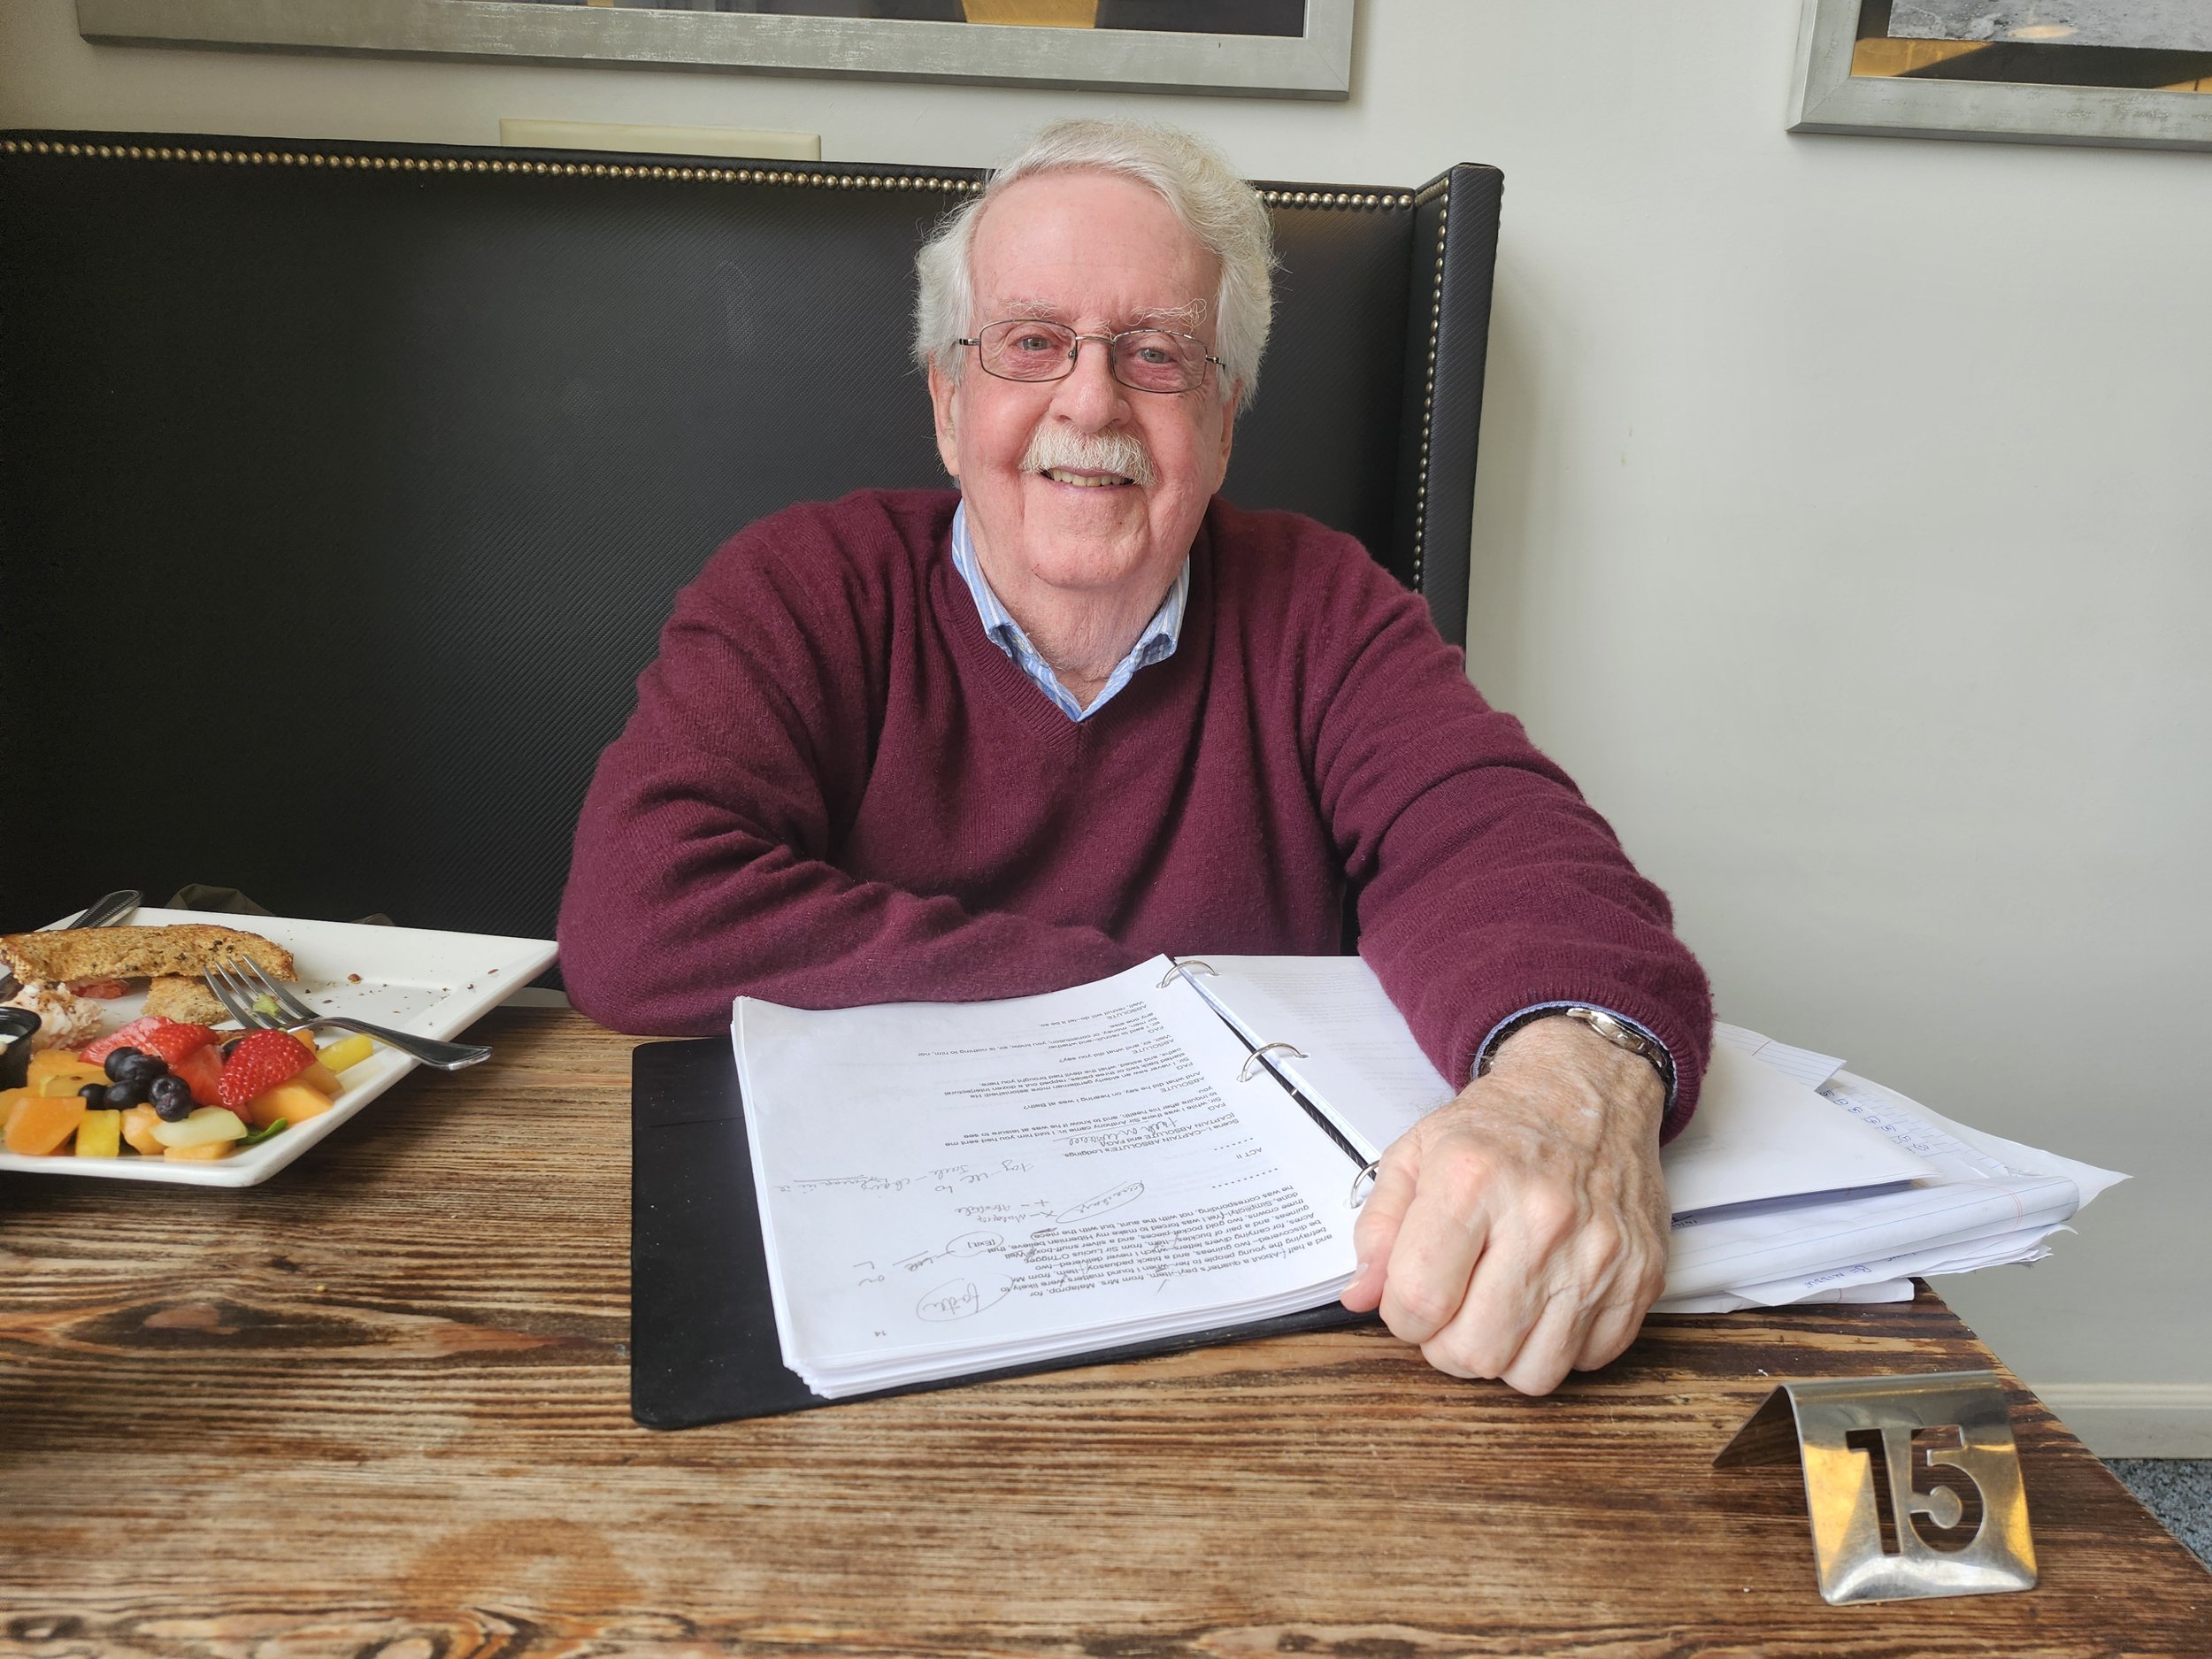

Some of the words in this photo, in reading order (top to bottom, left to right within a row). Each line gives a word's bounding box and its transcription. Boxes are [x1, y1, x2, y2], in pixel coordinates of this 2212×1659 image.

[1160, 1052, 1185, 1063] started
[1150, 1063, 1171, 1071] never
[1185, 1071, 1200, 1079] And
[1160, 1076, 1204, 1093] ABSOLUTE
[984, 1088, 1028, 1097] astonished!
[1181, 1094, 1209, 1104] inquire
[1094, 1119, 1126, 1129] Anthony
[1212, 1118, 1239, 1129] Scene
[1143, 1125, 1192, 1140] ABSOLUTE
[1245, 1147, 1262, 1157] ACT
[1262, 1189, 1280, 1198] was
[1273, 1192, 1298, 1202] done,
[1281, 1198, 1303, 1209] three
[1271, 1204, 1309, 1220] guineas,
[1252, 1217, 1270, 1227] and
[1286, 1212, 1314, 1225] Acres,
[1150, 1222, 1179, 1231] forced
[1205, 1219, 1225, 1230] gold
[1225, 1224, 1242, 1233] pair
[1233, 1226, 1271, 1240] carrying
[1285, 1226, 1326, 1244] betraying
[1047, 1234, 1094, 1244] Hibernian
[1204, 1236, 1232, 1245] divers
[1233, 1240, 1251, 1248] two
[1315, 1233, 1333, 1245] and
[1008, 1240, 1046, 1251] believe,
[1193, 1243, 1232, 1255] guineas,
[1237, 1244, 1266, 1256] young
[1287, 1243, 1305, 1254] half
[1071, 1248, 1103, 1256] Lucius
[1203, 1251, 1235, 1263] people
[1200, 1260, 1240, 1271] quarter's
[1067, 1272, 1104, 1282] matters
[1106, 1267, 1134, 1277] found
[1046, 1282, 1094, 1294] Malaprop,
[1845, 1425, 1987, 1556] 15
